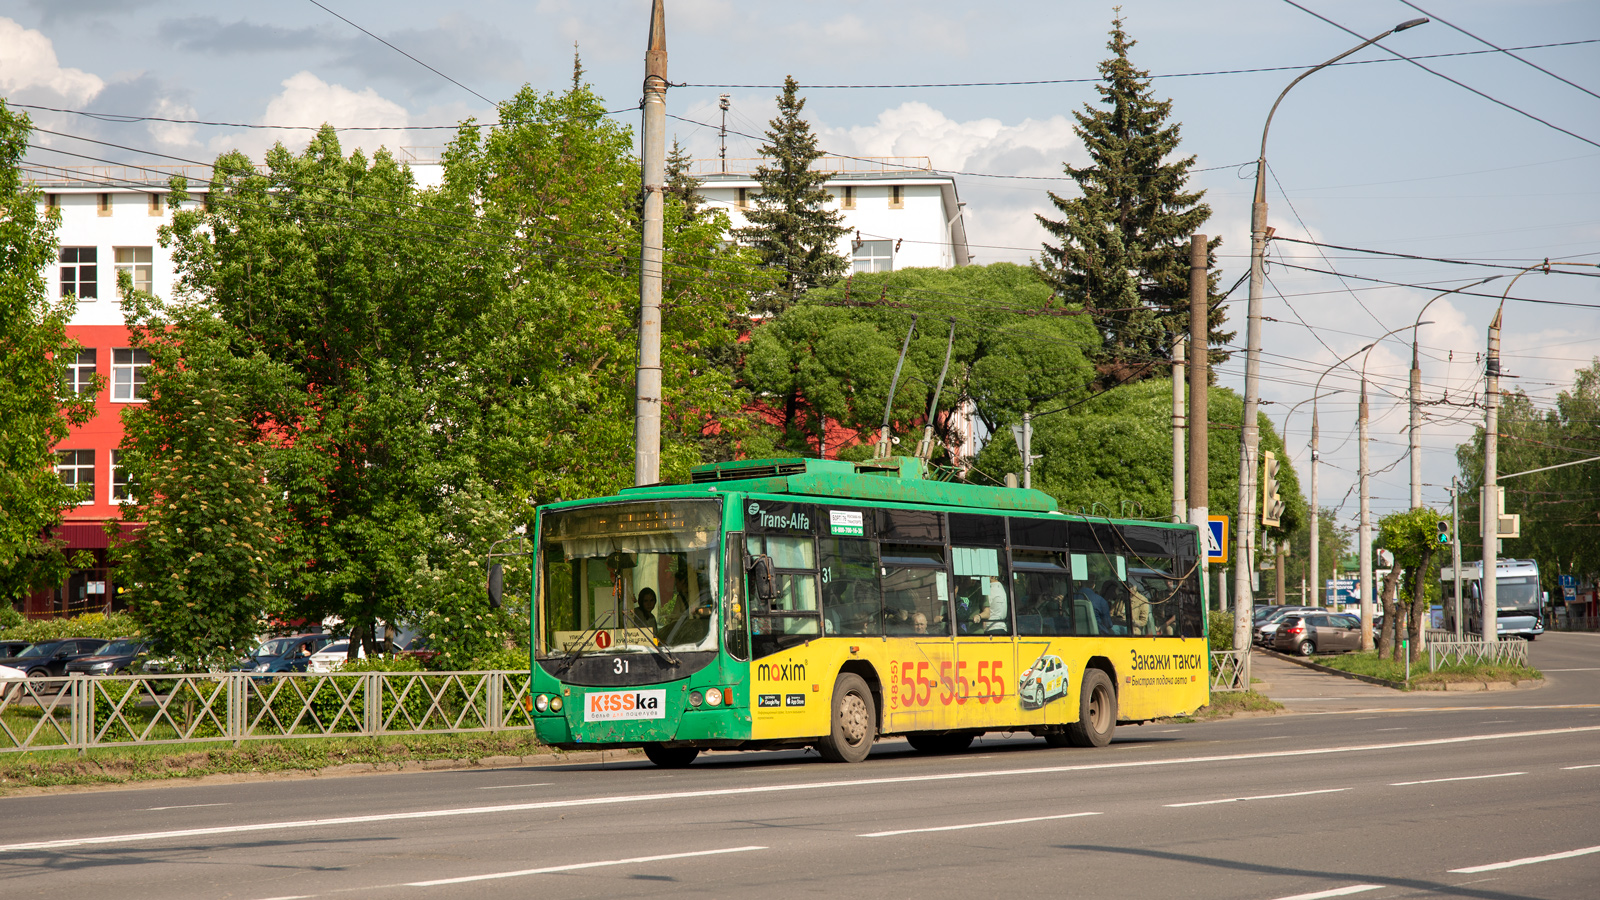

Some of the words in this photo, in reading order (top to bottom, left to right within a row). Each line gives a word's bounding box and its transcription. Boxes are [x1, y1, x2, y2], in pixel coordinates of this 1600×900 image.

[759, 510, 810, 530] Trans-Alfa
[822, 566, 832, 583] 31
[599, 631, 607, 647] 1
[613, 657, 629, 675] 31
[1130, 649, 1171, 670] Закажи
[1172, 654, 1202, 670] такси
[889, 659, 899, 710] (4855)
[1131, 675, 1155, 688] Быстрая
[1155, 674, 1173, 686] подача
[1174, 676, 1188, 685] авто
